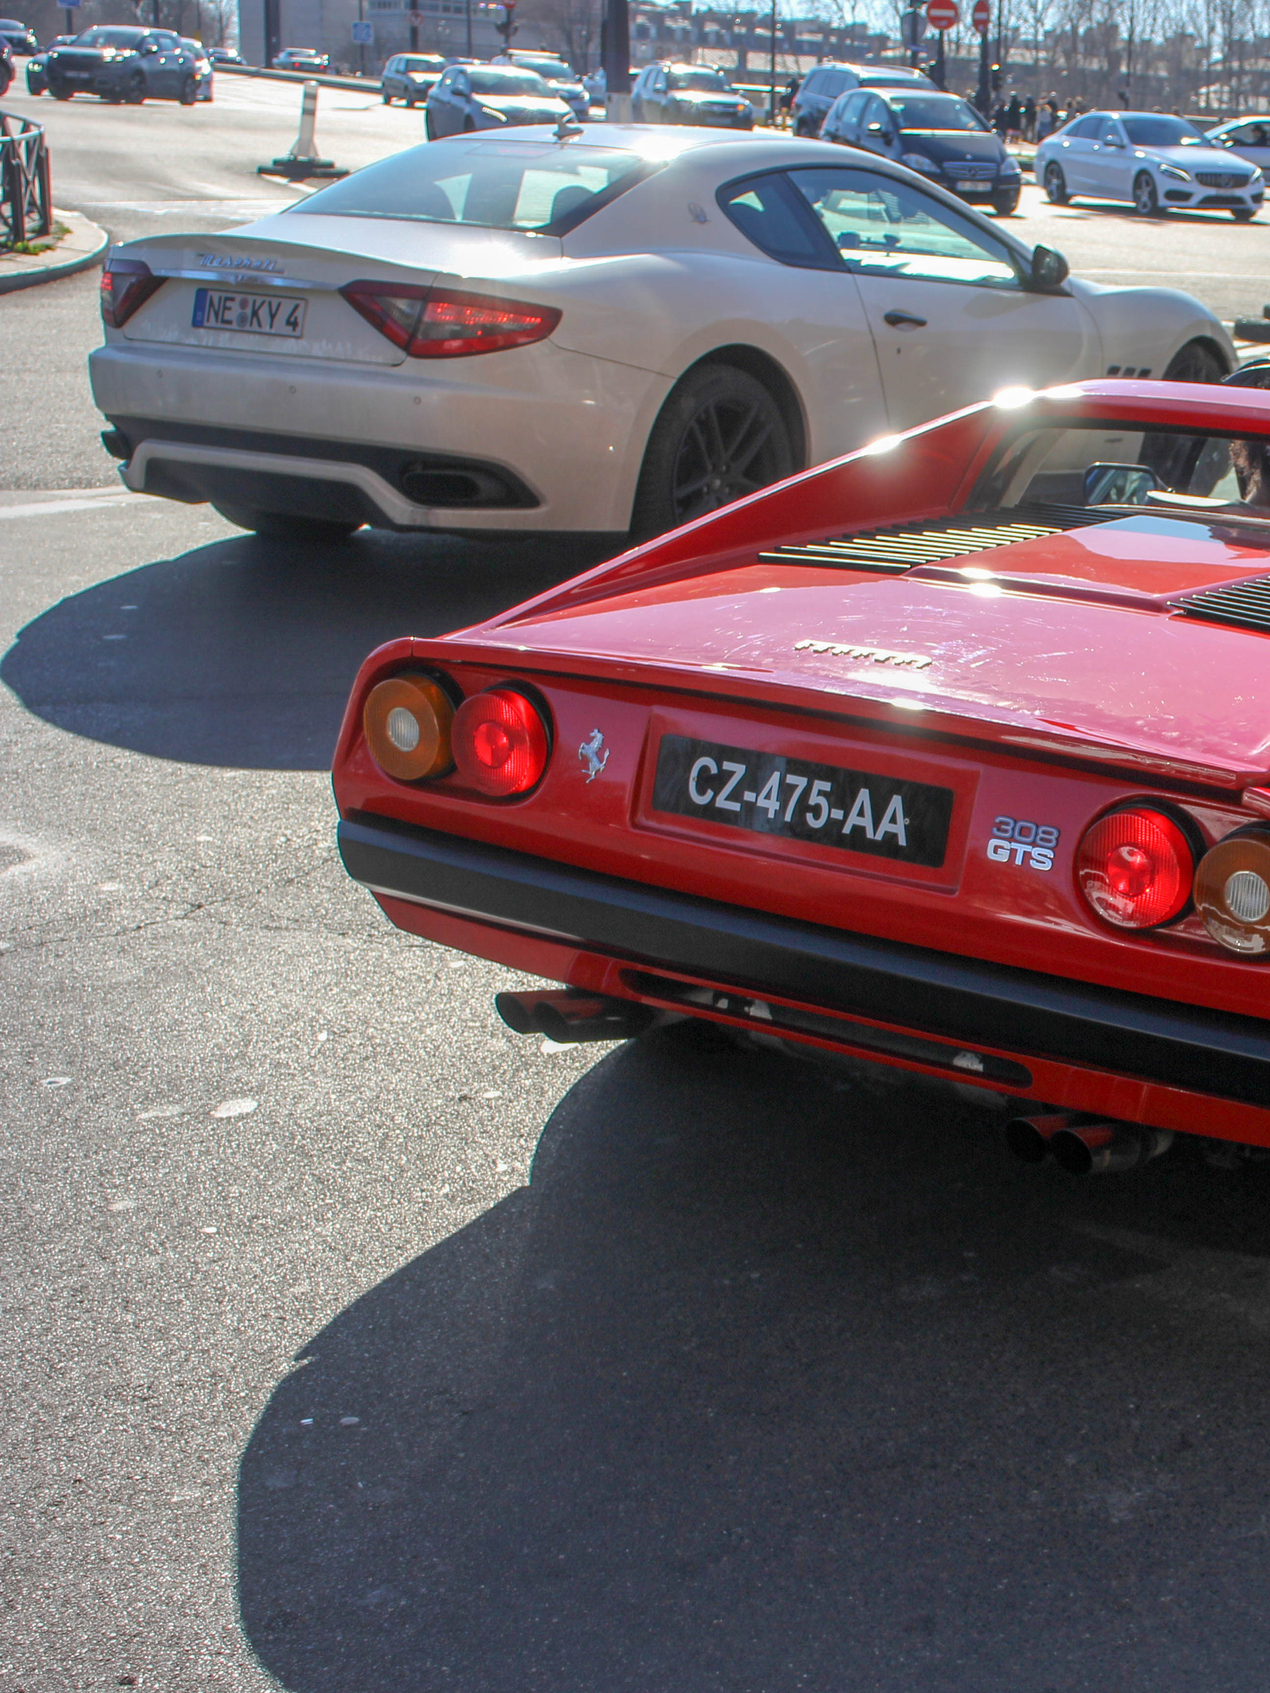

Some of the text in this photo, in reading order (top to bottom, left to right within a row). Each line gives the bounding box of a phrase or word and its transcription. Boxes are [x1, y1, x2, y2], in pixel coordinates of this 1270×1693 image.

[206, 294, 300, 332] NE KY 4
[688, 756, 907, 846] CZ-475-AA
[992, 815, 1060, 848] 308
[987, 838, 1055, 871] GTS
